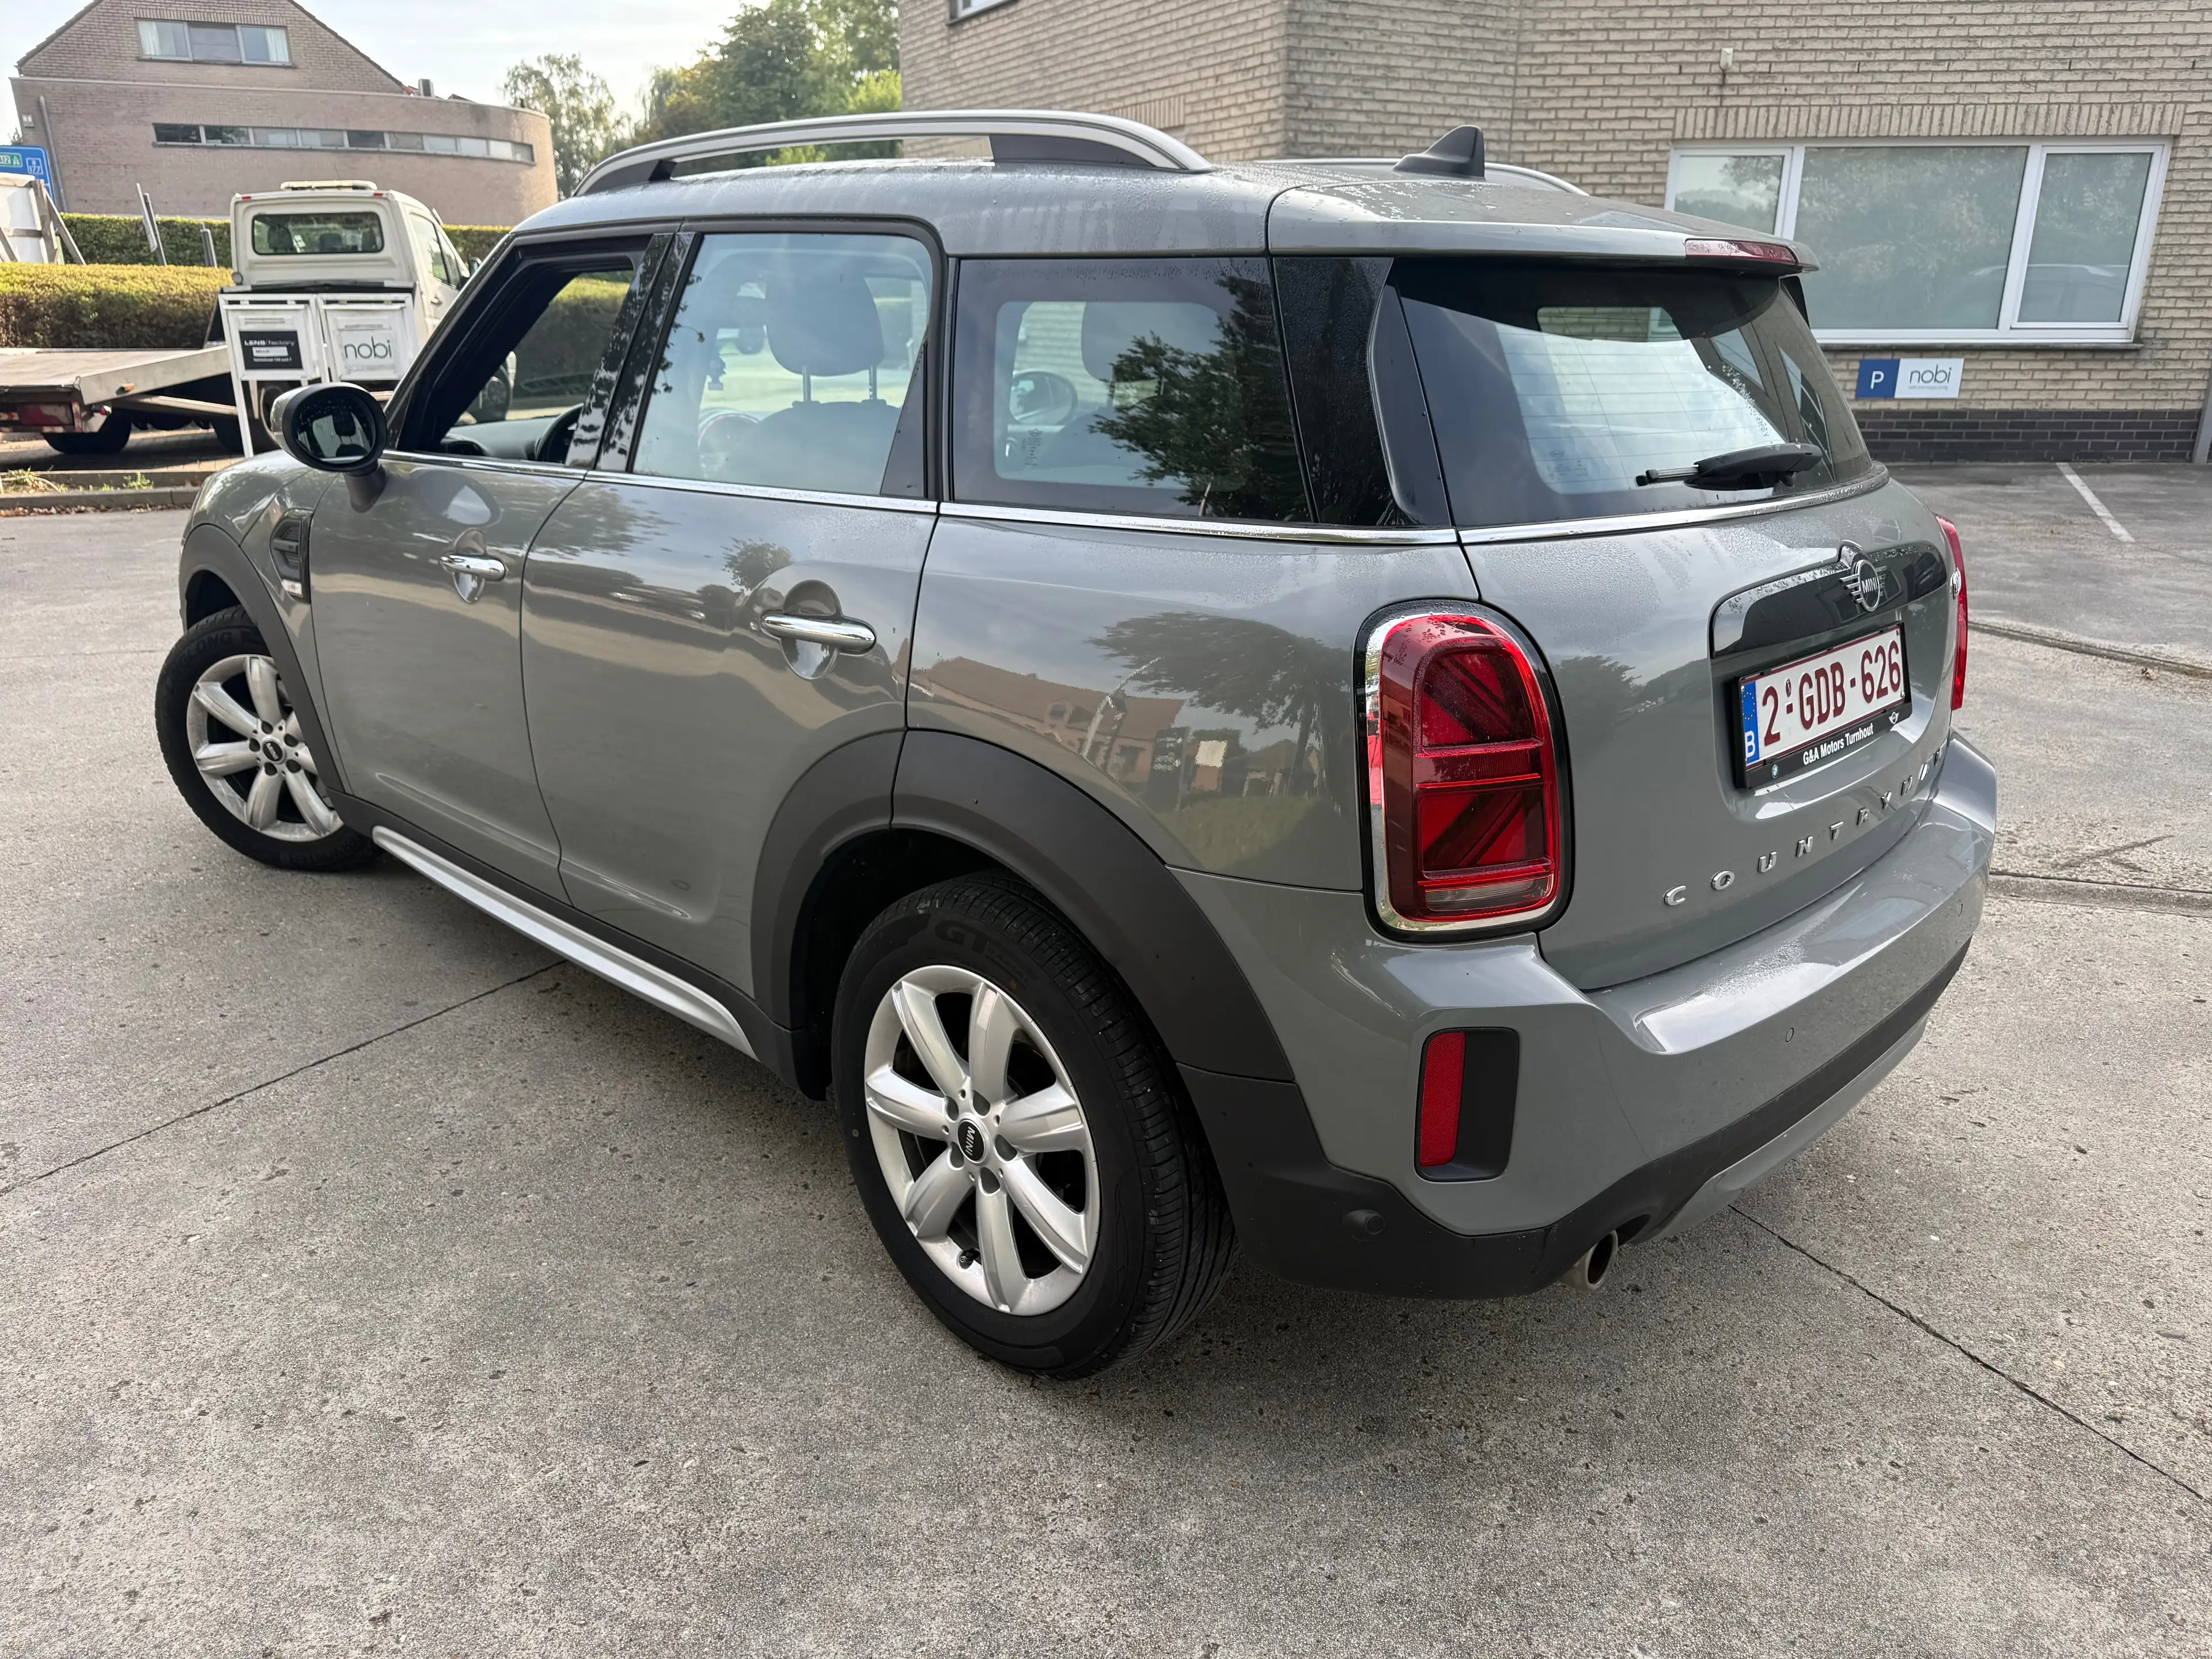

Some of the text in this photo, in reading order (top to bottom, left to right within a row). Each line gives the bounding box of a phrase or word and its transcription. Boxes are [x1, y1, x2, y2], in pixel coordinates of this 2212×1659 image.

[344, 335, 392, 359] nobi
[1870, 370, 1884, 389] P
[1909, 363, 1952, 384] nobi
[1861, 576, 1878, 594] MINI
[1745, 730, 1756, 759] B
[1802, 722, 1874, 766] G&A Motors Turnhout
[965, 1126, 976, 1156] MINI
